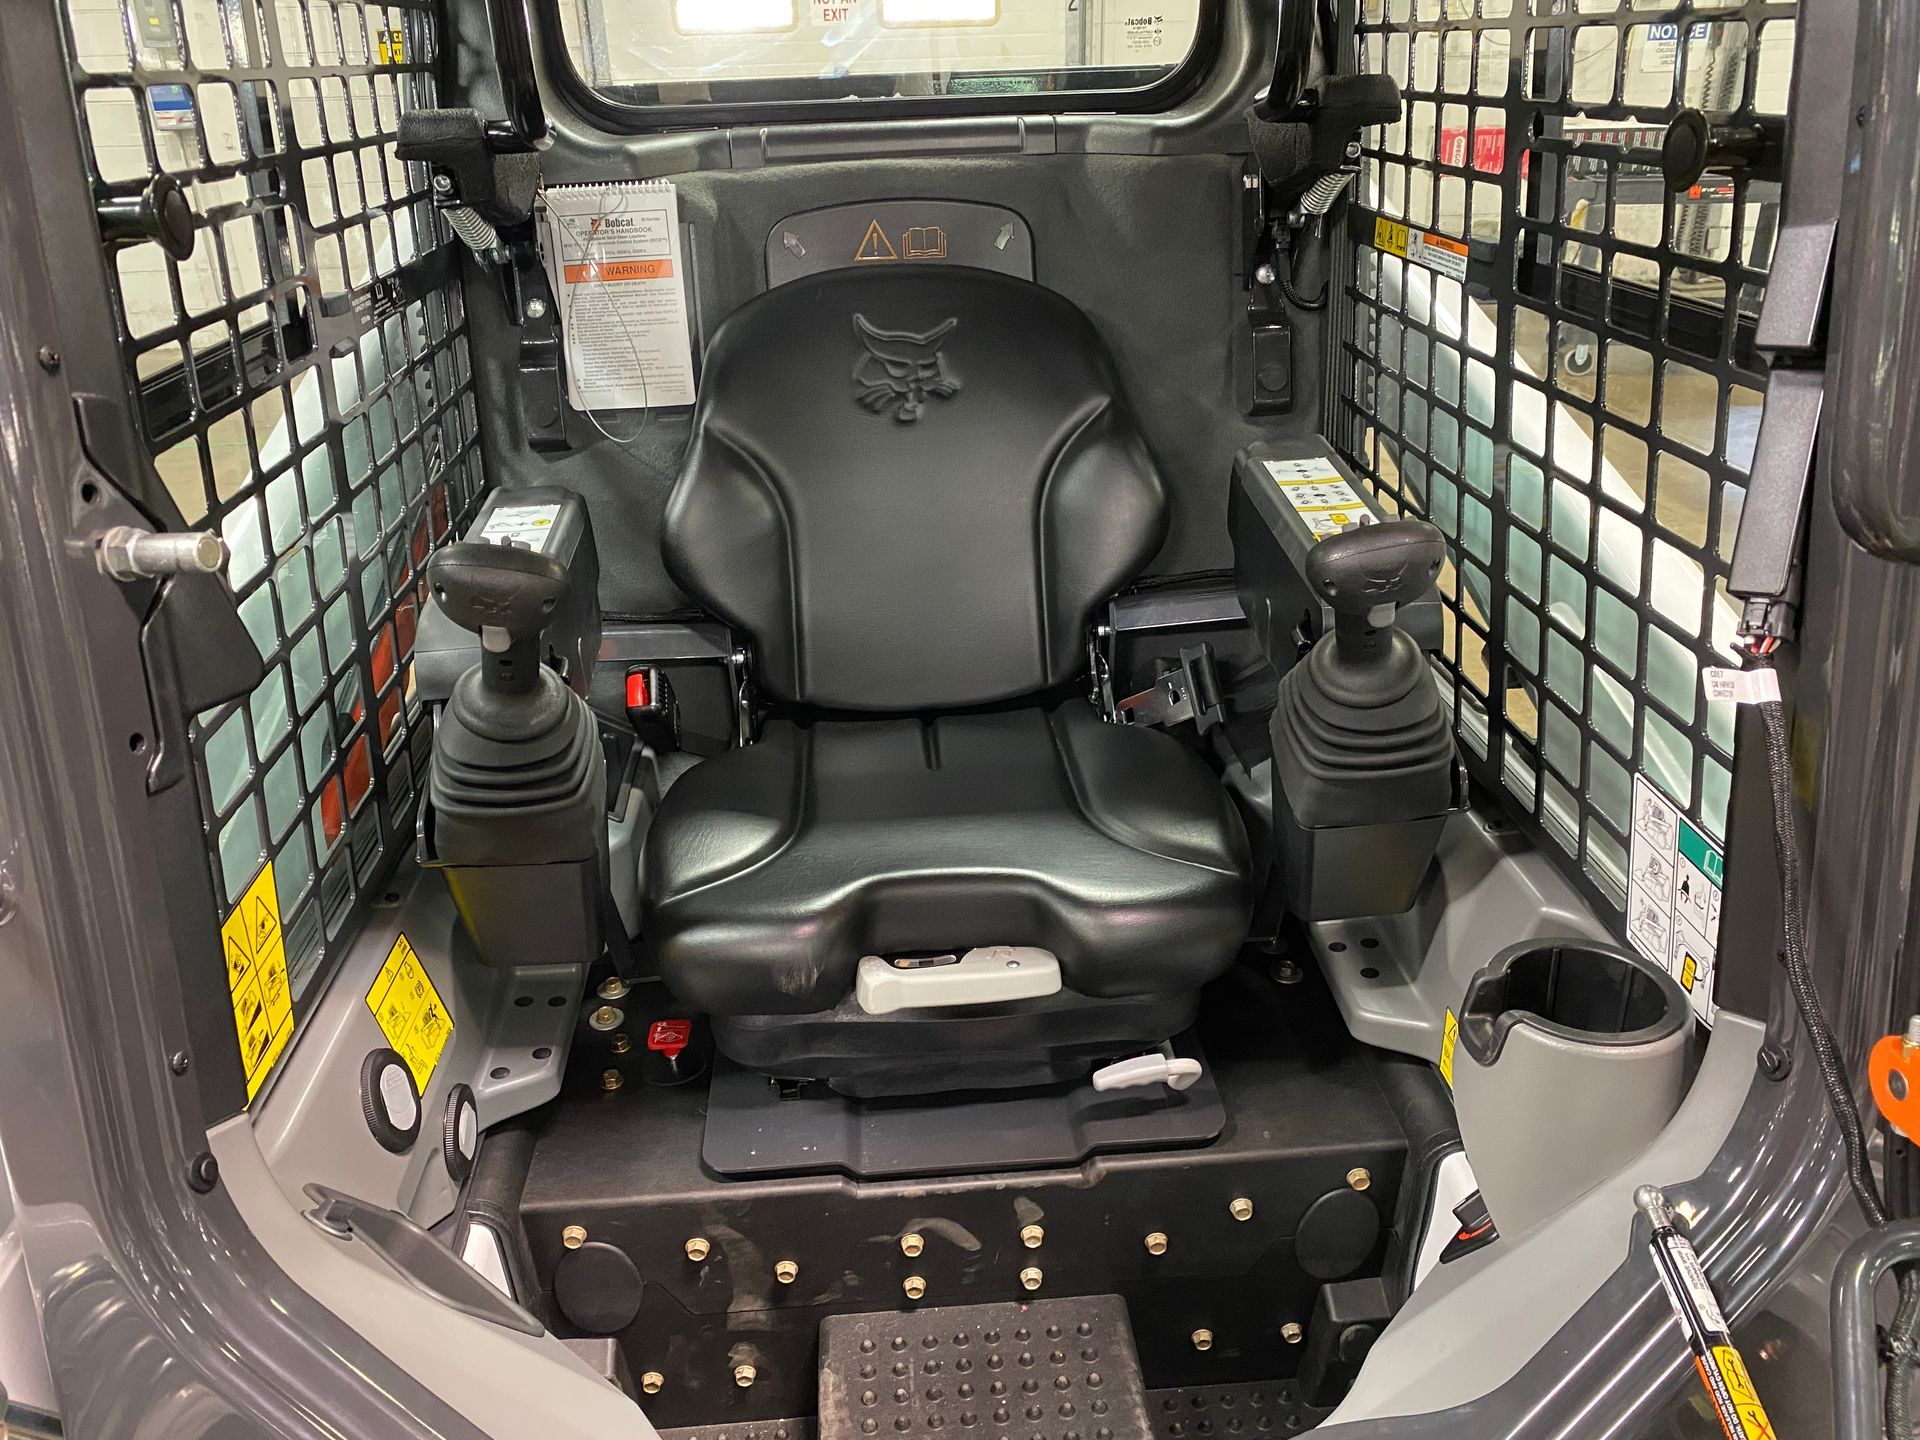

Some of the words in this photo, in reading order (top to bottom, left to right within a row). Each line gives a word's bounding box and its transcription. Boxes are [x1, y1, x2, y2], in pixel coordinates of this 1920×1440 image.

[823, 8, 848, 21] EXIT
[605, 218, 634, 228] Bobcat
[616, 226, 653, 234] HANDBOOK
[605, 264, 656, 276] WARNING
[1701, 1355, 1712, 1376] CAUSE
[1709, 1375, 1718, 1390] AND
[1717, 1380, 1729, 1400] OPEN
[1725, 1399, 1735, 1414] NOT
[1731, 1413, 1739, 1425] DO
